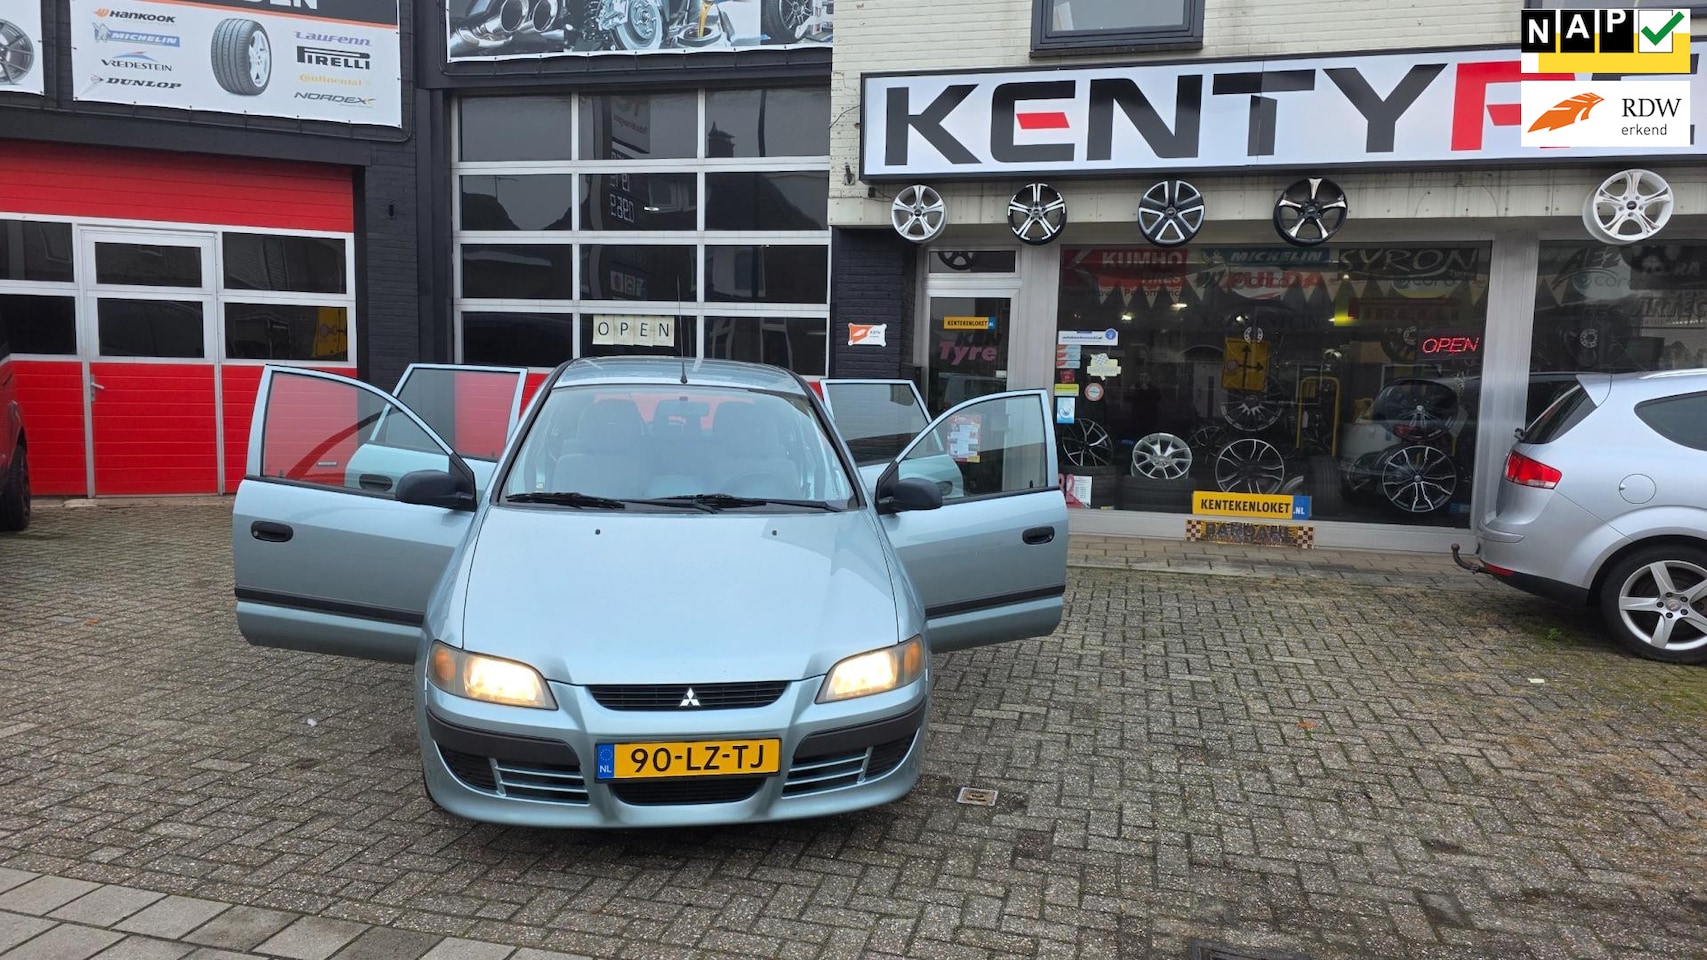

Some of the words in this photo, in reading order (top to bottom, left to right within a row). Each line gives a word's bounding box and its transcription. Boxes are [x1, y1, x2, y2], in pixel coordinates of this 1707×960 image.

[111, 33, 177, 44] MICHELIN
[101, 59, 172, 71] VREDESTEIN
[297, 45, 370, 70] PIRELLI
[106, 77, 182, 89] DUNLOP
[294, 91, 376, 105] NORDEX
[885, 53, 1698, 166] KENTYR
[1230, 250, 1323, 262] MICHELIN
[598, 322, 670, 337] OPEN
[1422, 336, 1479, 354] OPEN
[938, 341, 998, 366] Tyre
[1201, 498, 1291, 514] KENTEKENLOKET
[630, 744, 765, 773] 90-LZ-TJ
[599, 764, 613, 774] NL
